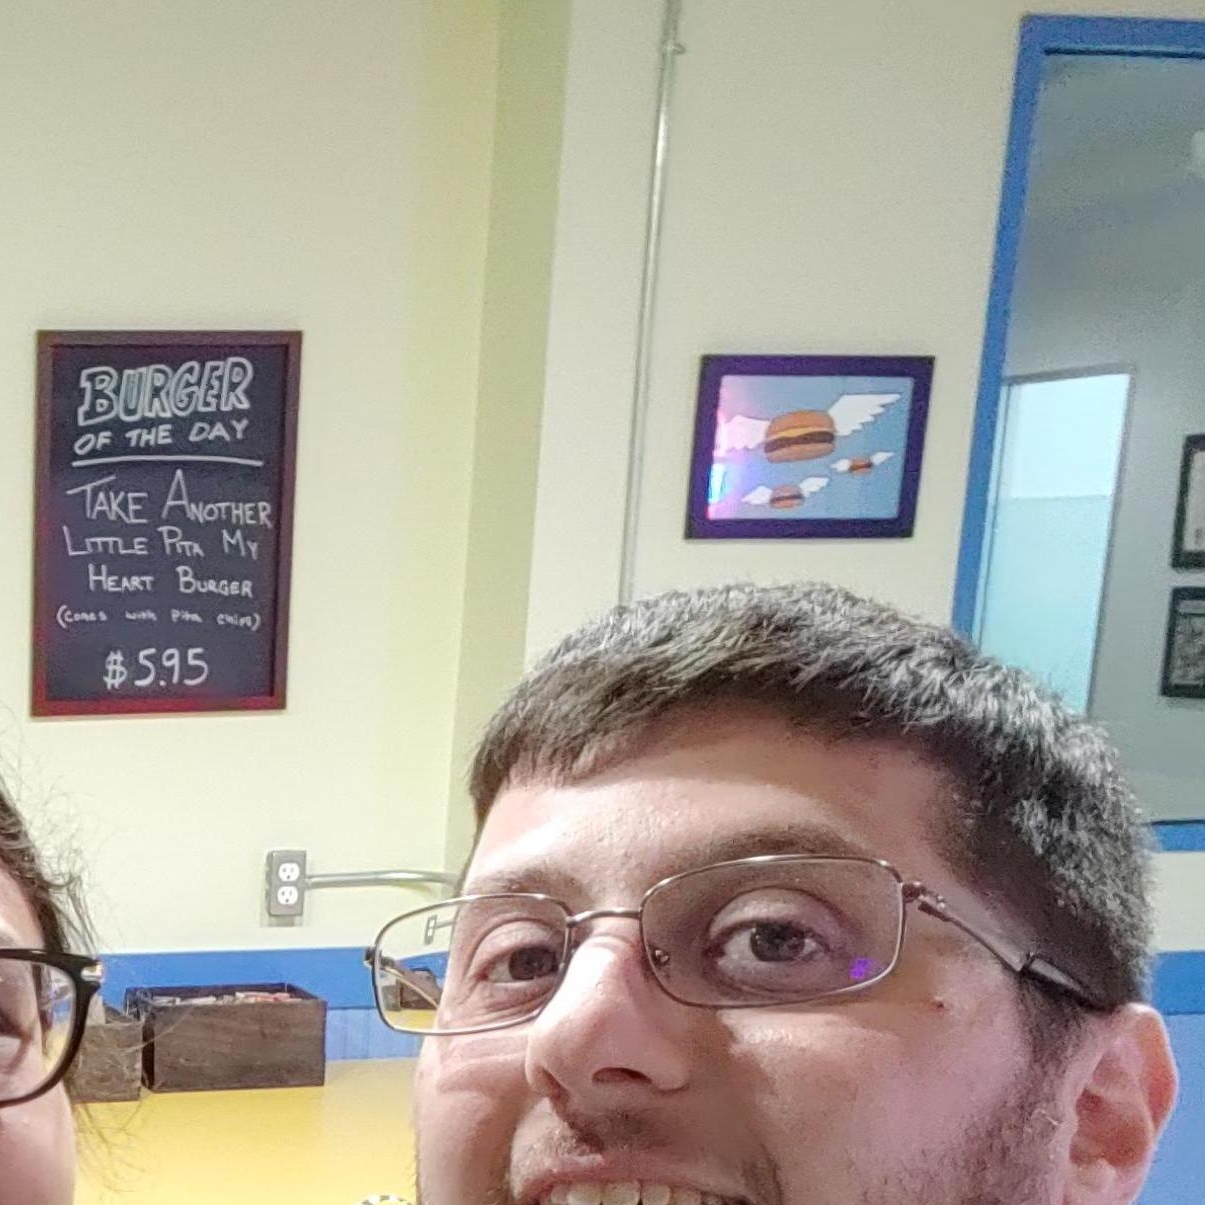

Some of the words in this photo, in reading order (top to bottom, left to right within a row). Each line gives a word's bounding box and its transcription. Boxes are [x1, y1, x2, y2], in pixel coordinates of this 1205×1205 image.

[77, 356, 254, 427] BURGER
[73, 430, 114, 456] OF
[125, 424, 173, 448] THE
[188, 418, 249, 442] DAY
[66, 474, 149, 524] TAKE
[161, 468, 273, 529] ANOTHER
[62, 525, 149, 556] LITTLE
[157, 525, 205, 557] PITA
[221, 528, 259, 560] MY
[88, 563, 155, 593] HEART
[175, 565, 253, 598] BURGER
